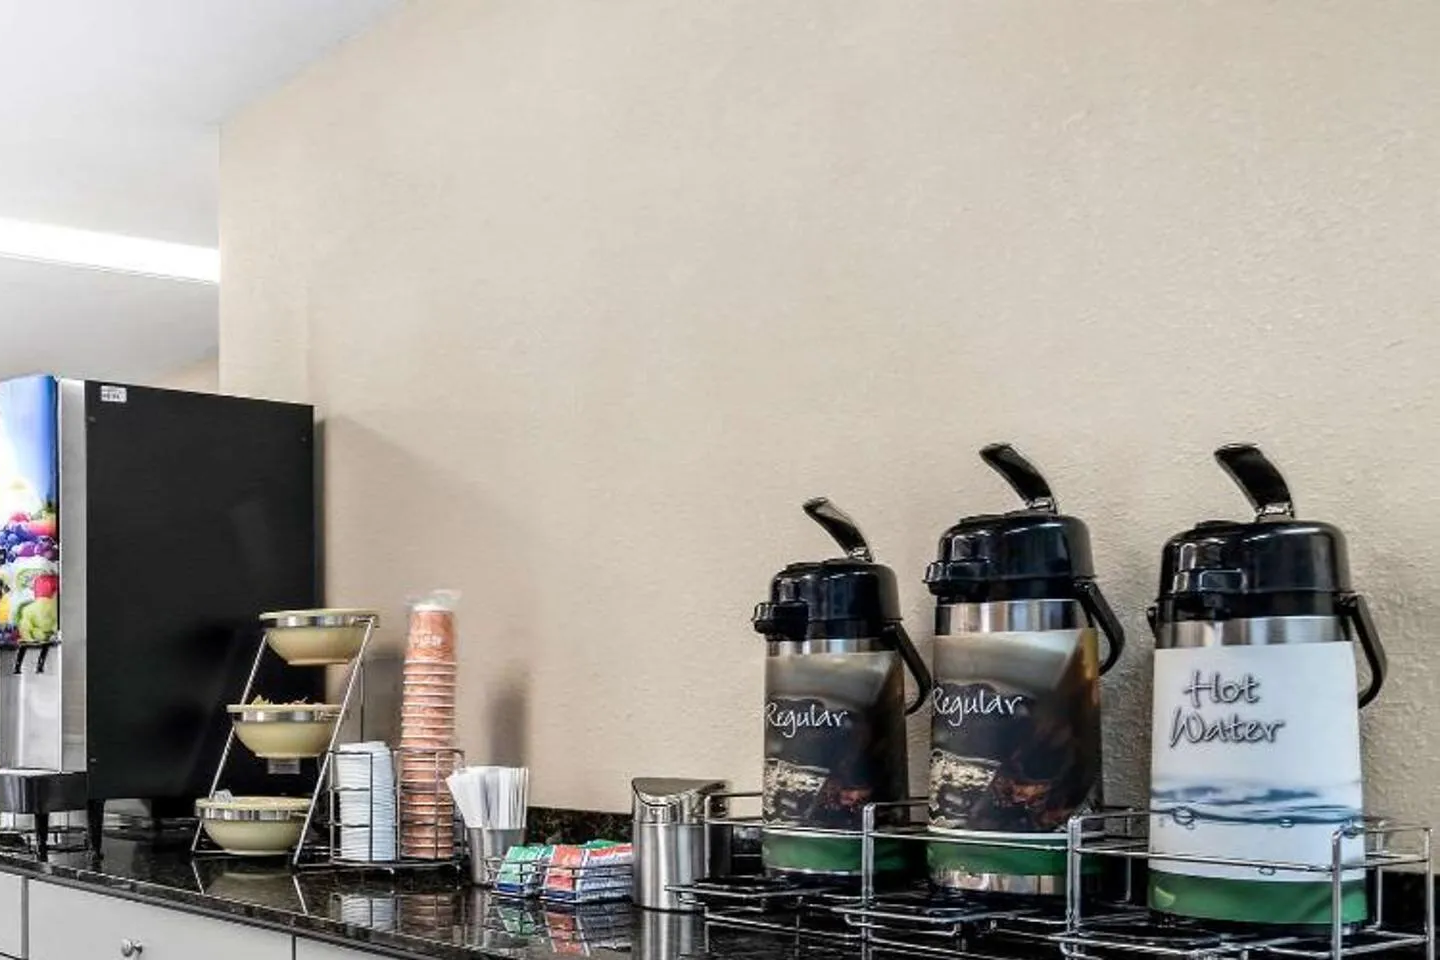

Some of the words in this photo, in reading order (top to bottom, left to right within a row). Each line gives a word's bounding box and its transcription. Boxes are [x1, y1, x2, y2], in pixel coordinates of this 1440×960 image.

[932, 686, 1023, 727] Regular
[1182, 669, 1262, 709] Hot
[765, 702, 849, 739] Regular
[1169, 706, 1286, 749] Water
